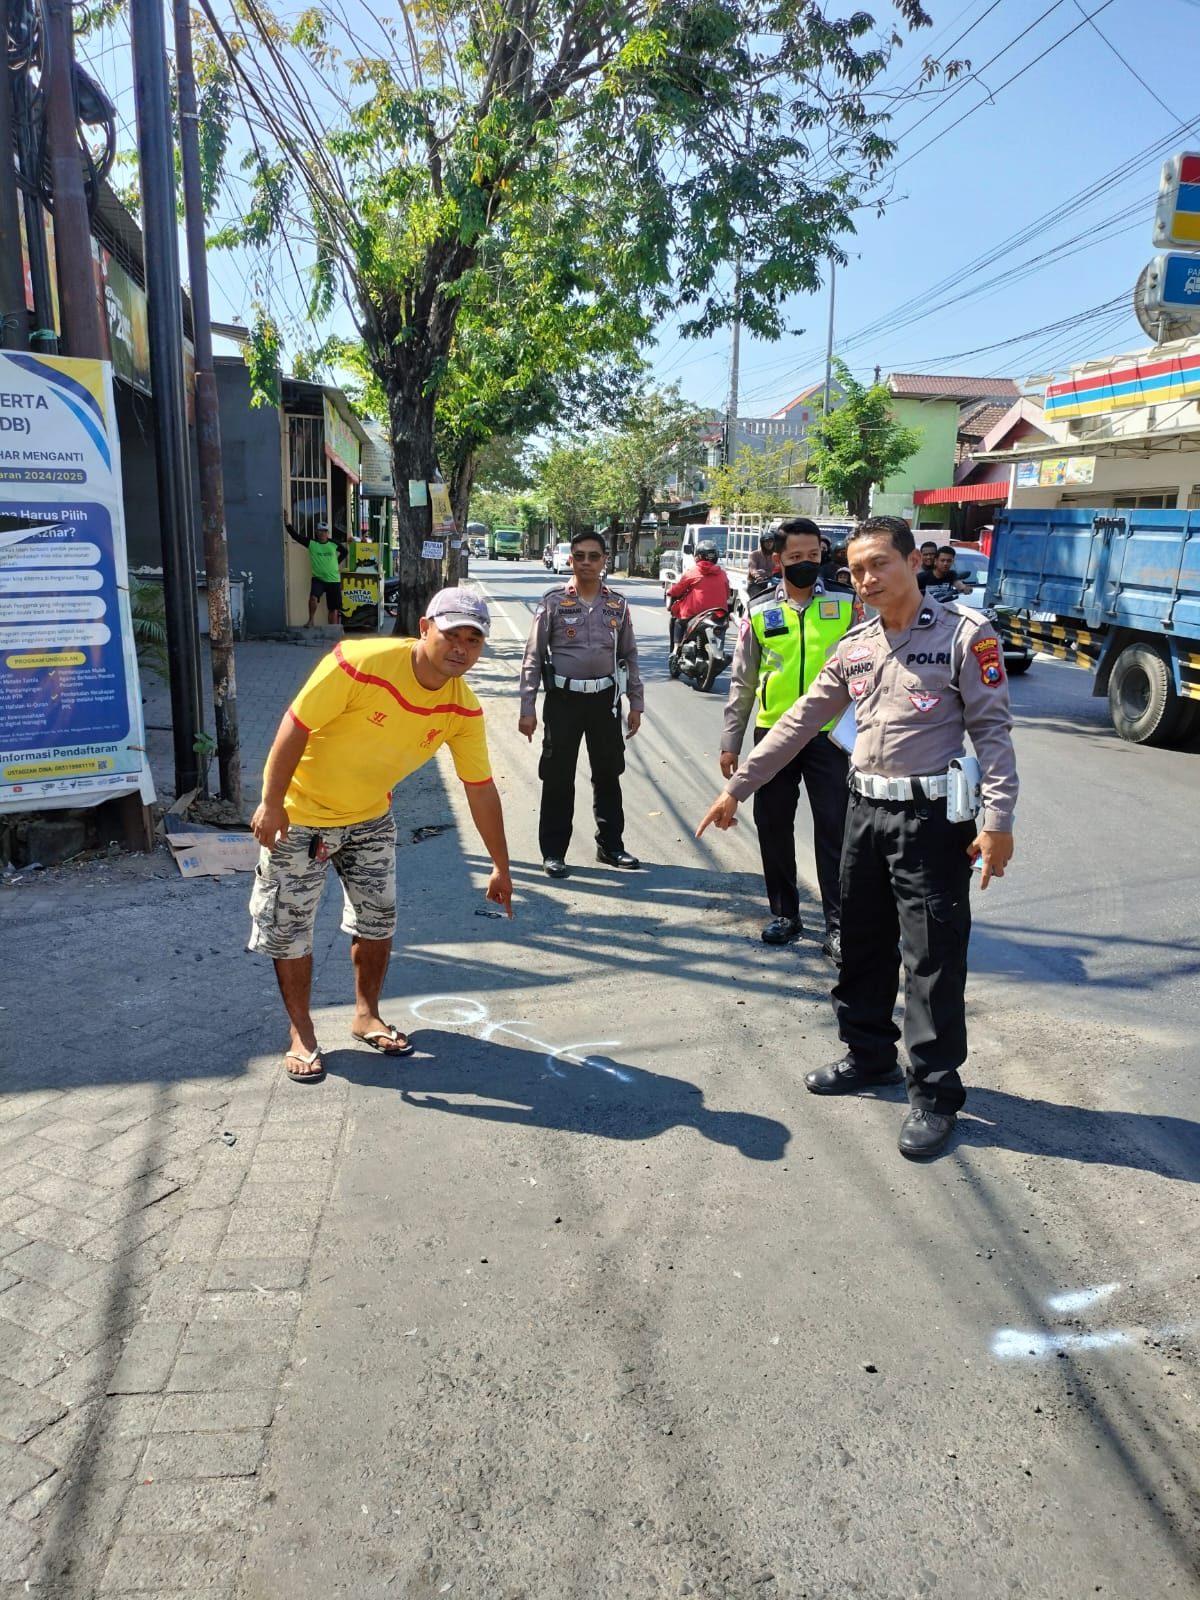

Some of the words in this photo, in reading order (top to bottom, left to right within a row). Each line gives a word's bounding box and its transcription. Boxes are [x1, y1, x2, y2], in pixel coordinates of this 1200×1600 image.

[0, 393, 49, 410] ERTA
[23, 451, 84, 462] MENGANTI
[25, 471, 83, 481] 2024/2025
[20, 510, 58, 520] Harus
[61, 510, 88, 521] Pilih
[907, 653, 951, 665] POLRI
[0, 750, 51, 763] Informasi
[53, 745, 118, 757] Pendaftaran
